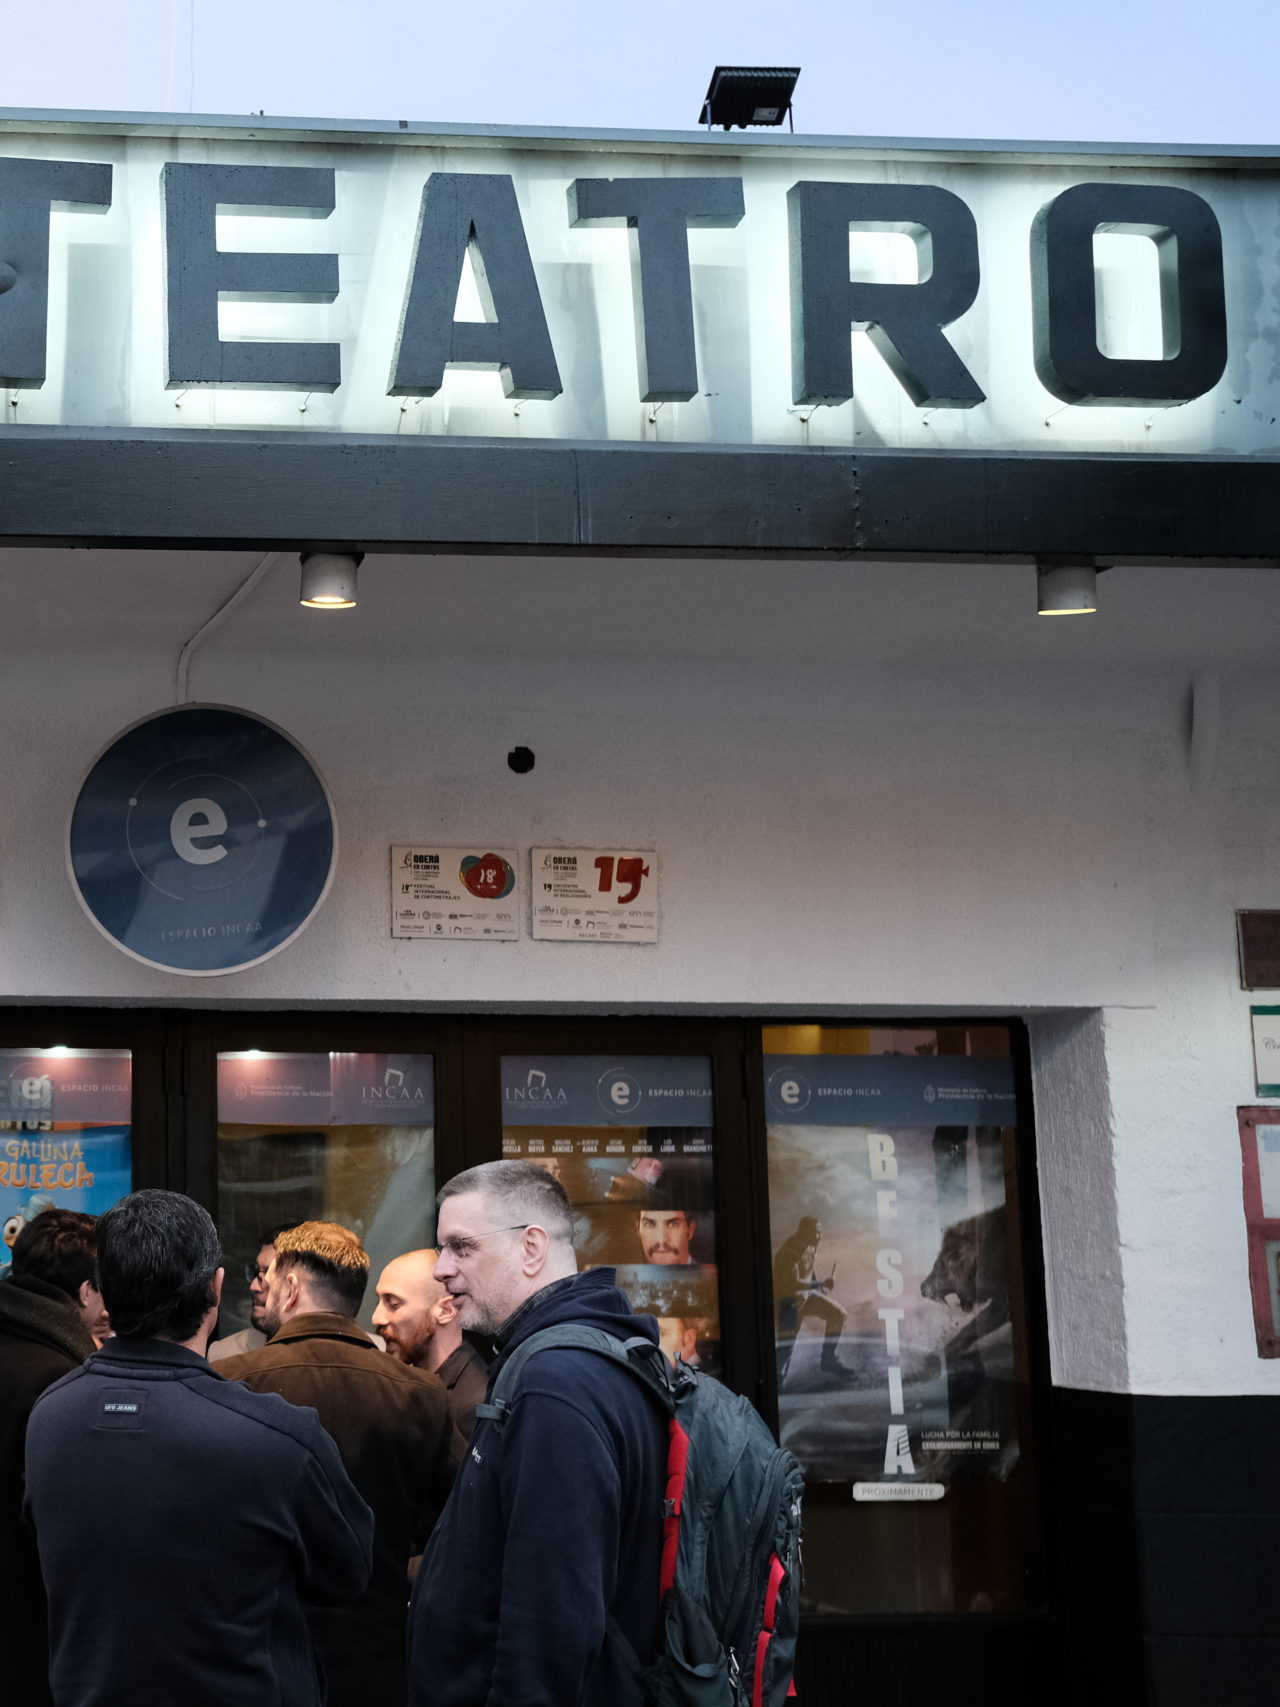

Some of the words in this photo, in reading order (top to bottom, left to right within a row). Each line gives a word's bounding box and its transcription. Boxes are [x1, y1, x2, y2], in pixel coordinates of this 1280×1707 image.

[170, 797, 229, 865] e
[413, 854, 439, 863] OBERÁ
[160, 925, 217, 942] ESPACIO
[221, 921, 264, 936] INCAA
[61, 1084, 99, 1093] ESPACIO
[101, 1084, 129, 1093] INCAA
[250, 1089, 290, 1097] Presidencia
[361, 1086, 424, 1099] INCAA
[505, 1087, 567, 1101] INCAA
[610, 1081, 630, 1105] e
[648, 1088, 684, 1097] ESPACIO
[780, 1080, 800, 1104] e
[818, 1087, 853, 1097] ESPACIO
[855, 1088, 881, 1097] INCAA
[938, 1092, 975, 1100] Presidencia
[5, 1138, 86, 1162] GALLINA
[867, 1133, 916, 1475] BESTIA
[921, 1431, 945, 1439] LUCHA
[946, 1431, 961, 1439] POR
[962, 1431, 971, 1439] LA
[972, 1431, 1000, 1439] FAMILIA
[861, 1486, 936, 1497] PRÓXIMAMENTE
